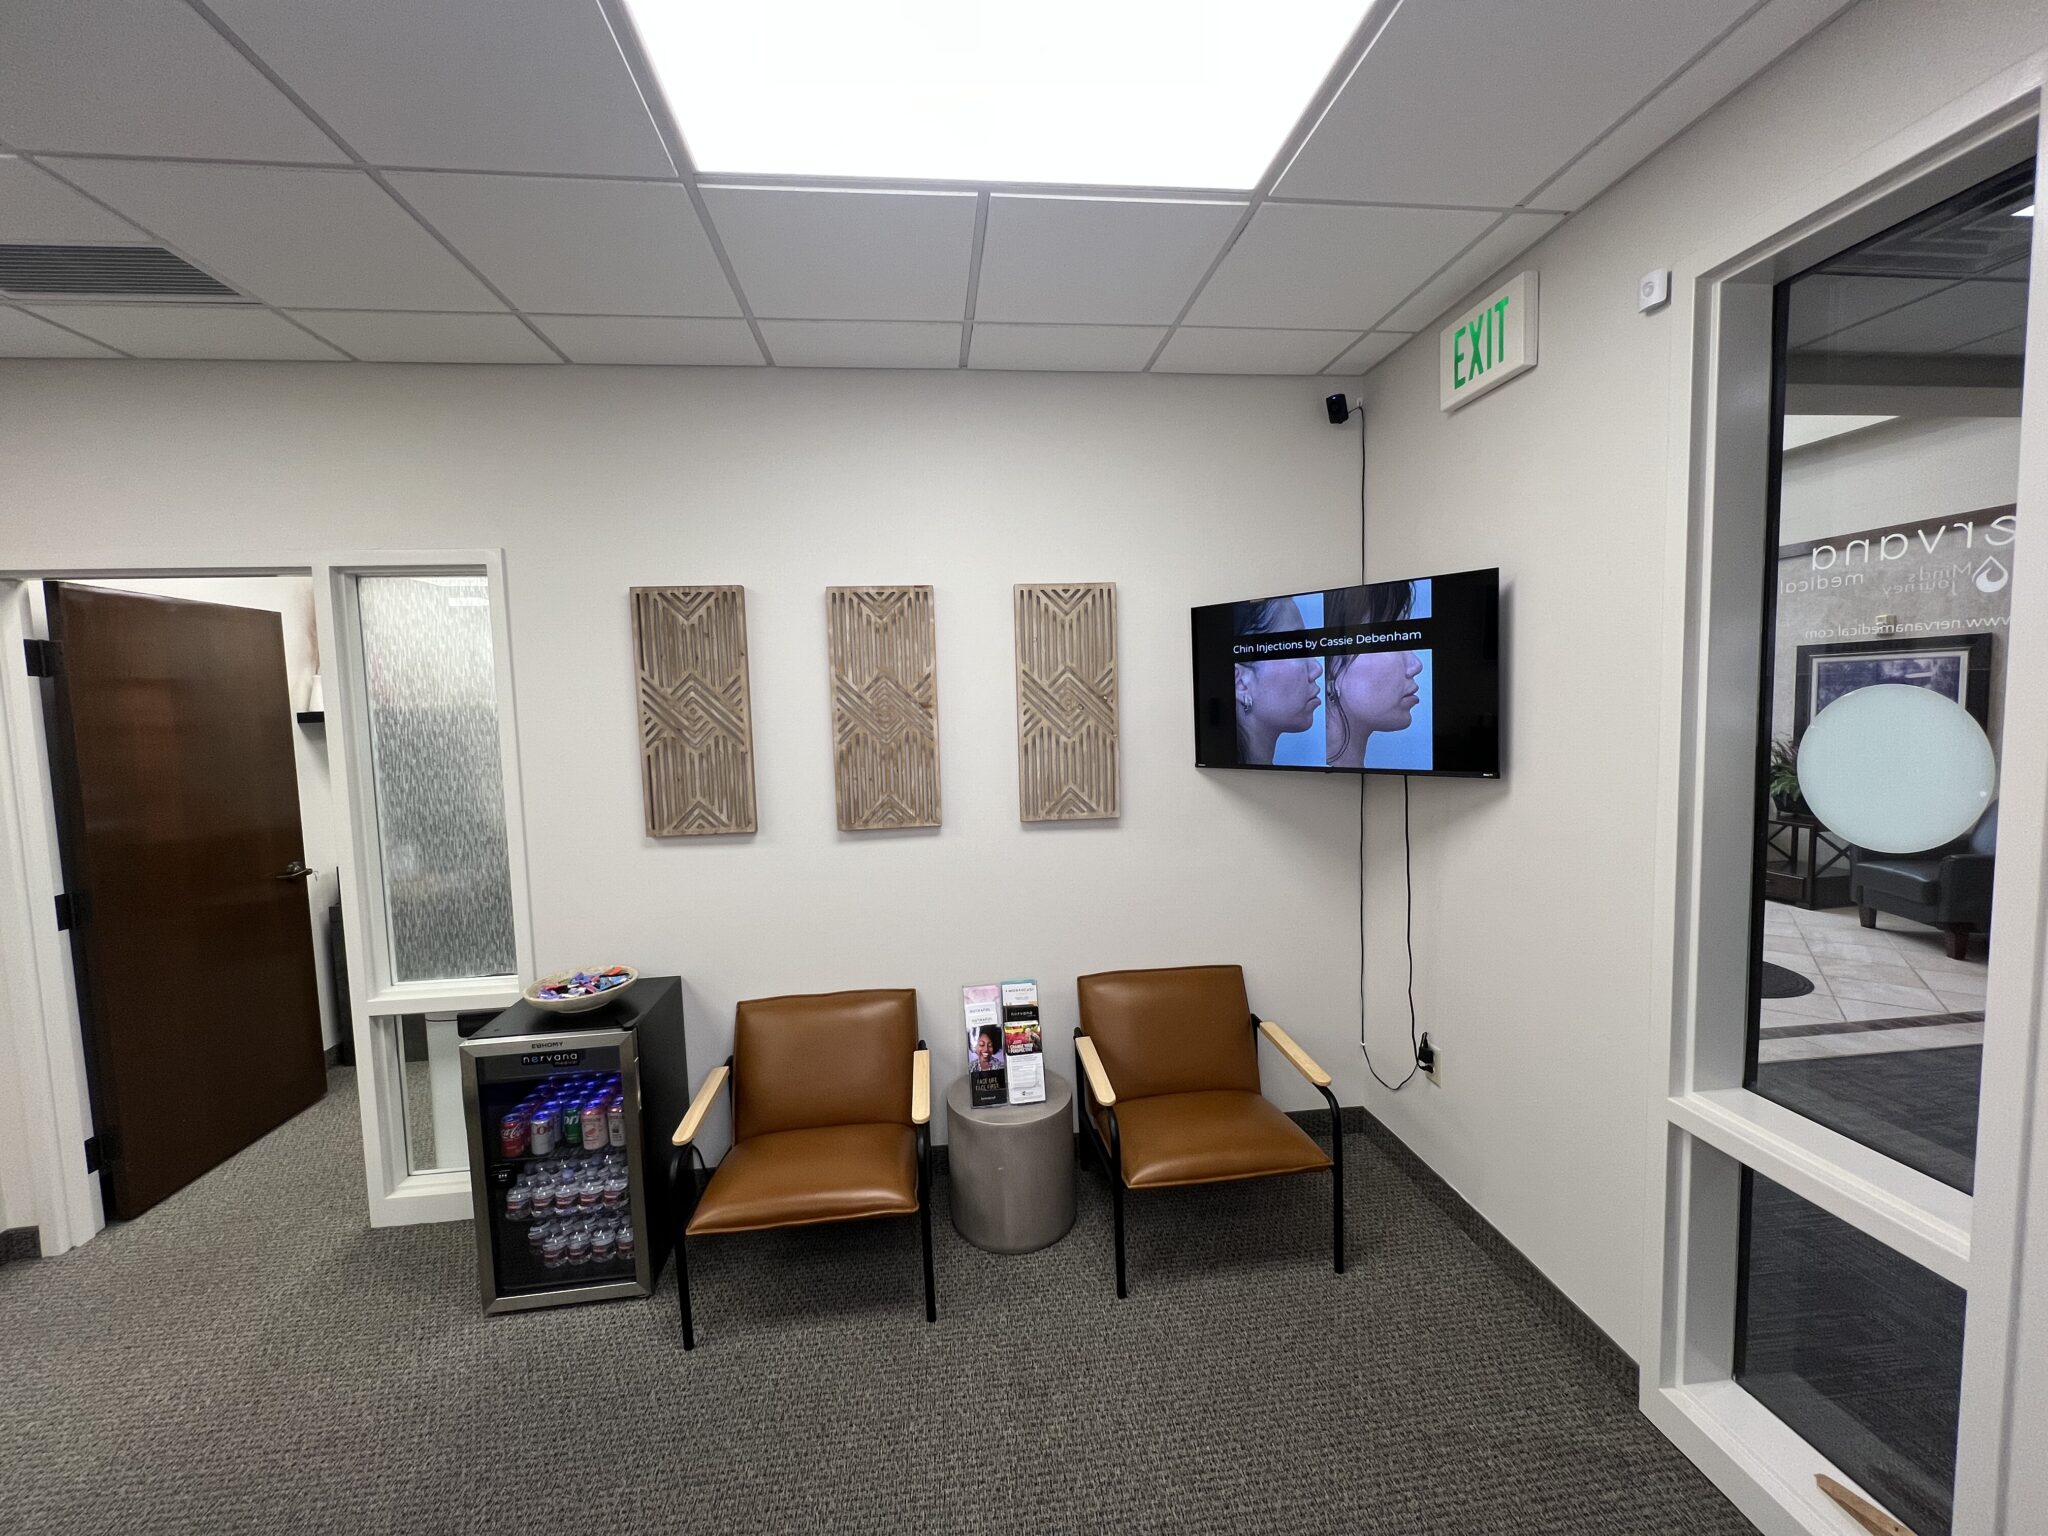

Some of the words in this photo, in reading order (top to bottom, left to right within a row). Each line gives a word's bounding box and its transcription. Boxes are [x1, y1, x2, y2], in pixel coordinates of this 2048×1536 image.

[1454, 295, 1509, 390] EXIT
[1233, 644, 1254, 654] Chin
[1256, 641, 1303, 654] Injections
[1305, 639, 1317, 650] by
[1320, 635, 1353, 647] Cassie
[1356, 631, 1422, 644] Debenham
[523, 1053, 578, 1063] nervana
